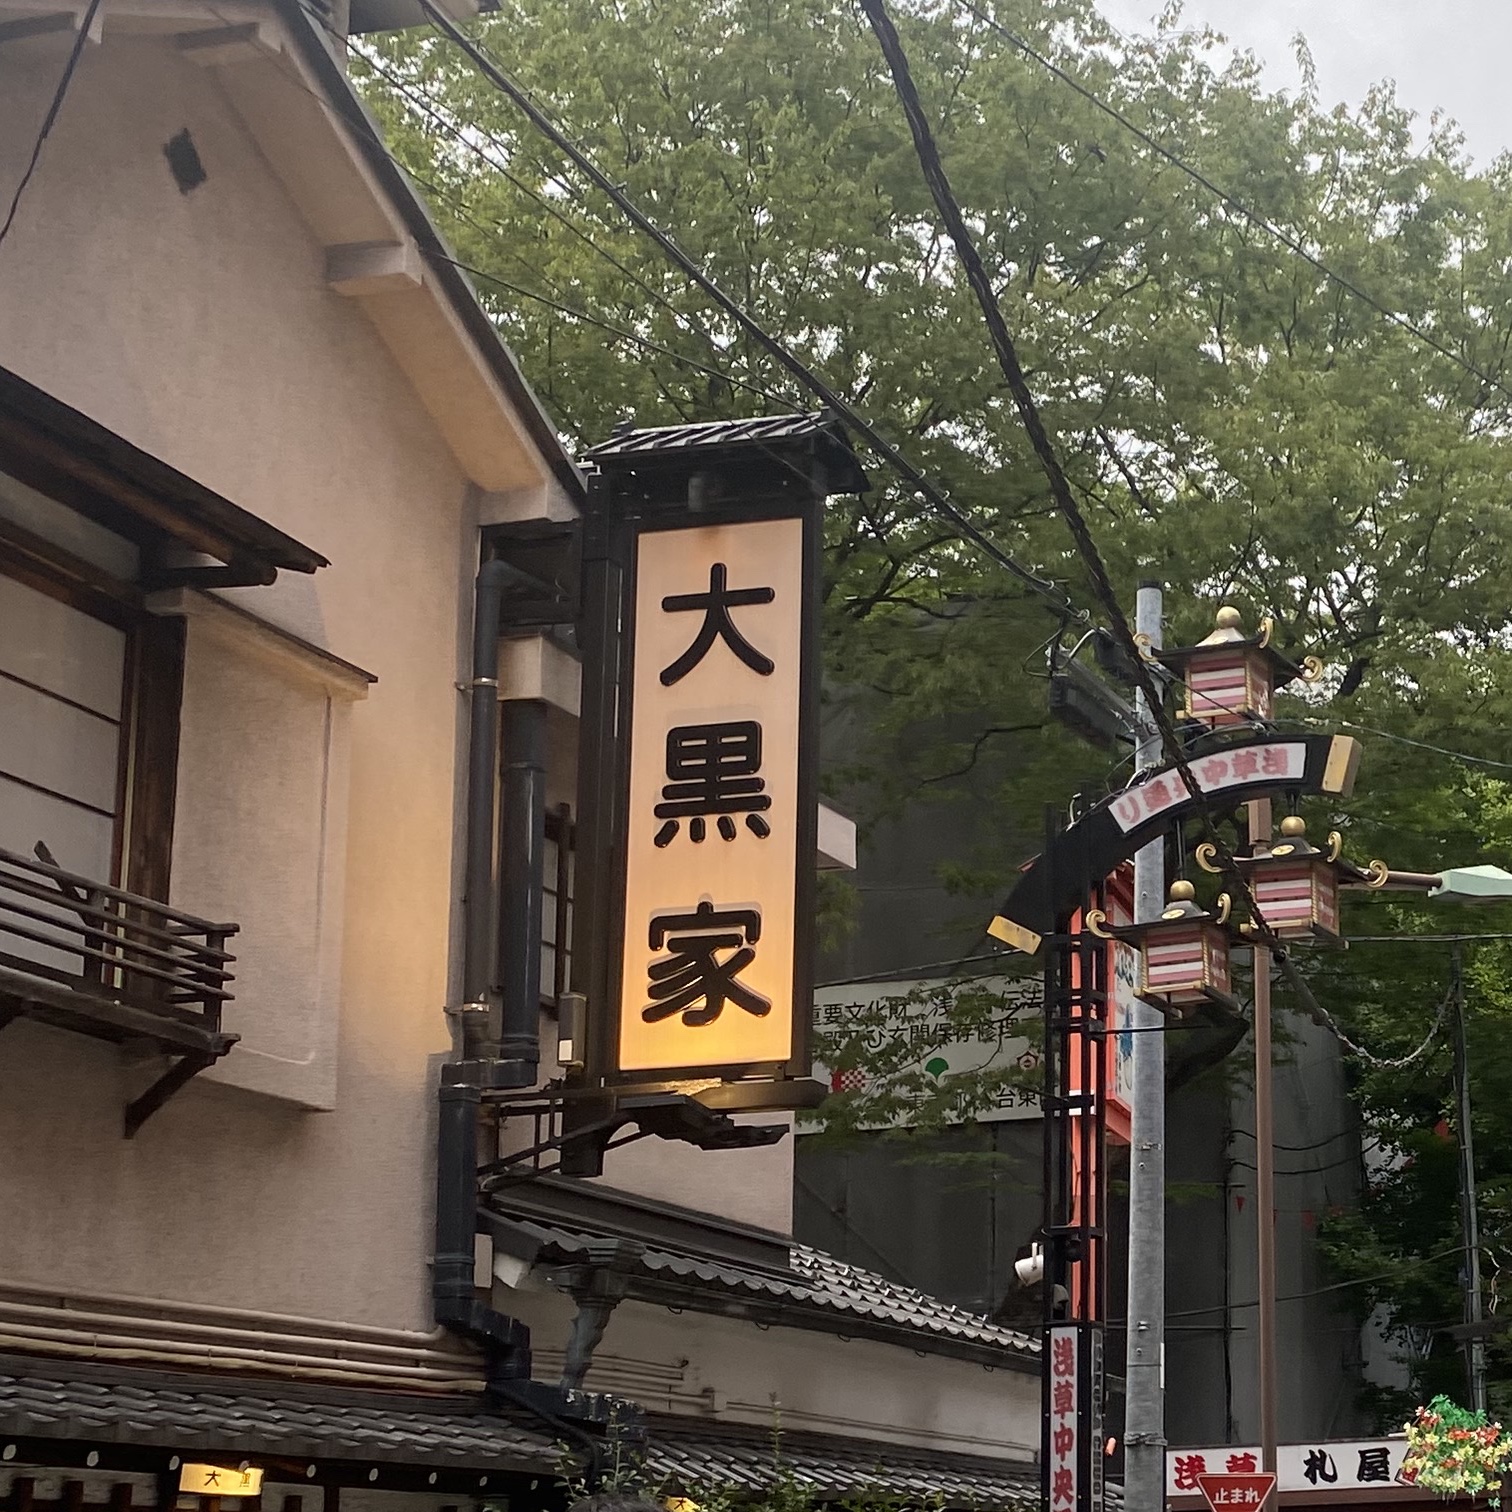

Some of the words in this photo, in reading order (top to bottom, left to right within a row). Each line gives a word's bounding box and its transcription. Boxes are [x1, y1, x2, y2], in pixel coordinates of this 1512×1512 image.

[642, 562, 775, 1027] 大黒家
[996, 1088, 1044, 1109] 台東
[1303, 1447, 1392, 1485] 札屋
[1213, 1487, 1261, 1505] 止まれ
